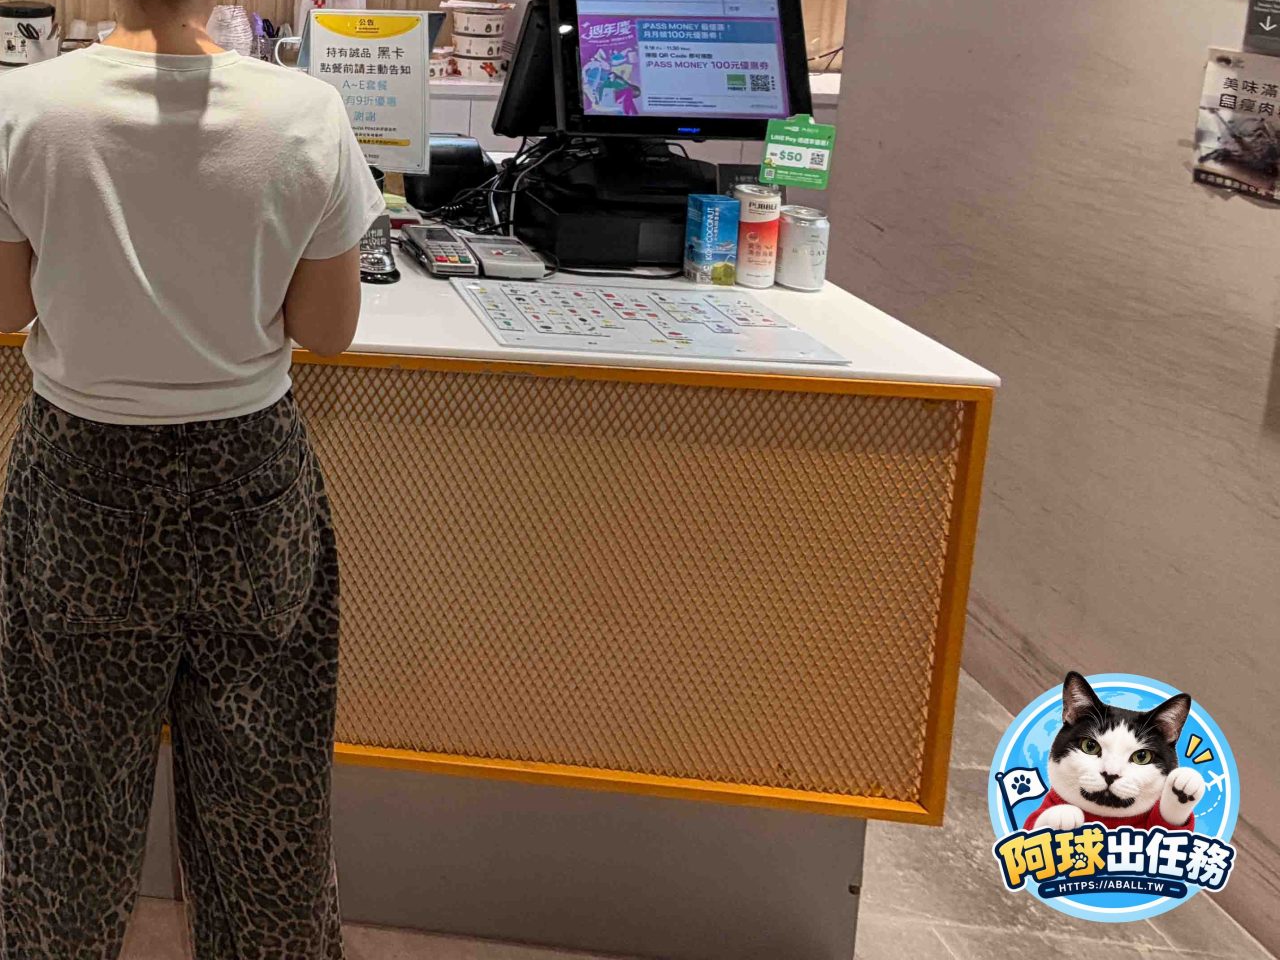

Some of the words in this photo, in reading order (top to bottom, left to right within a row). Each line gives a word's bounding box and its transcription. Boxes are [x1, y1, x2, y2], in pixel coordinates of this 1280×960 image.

[358, 18, 374, 26] 公告
[326, 46, 371, 59] 持有誠品
[377, 46, 405, 59] 黑卡
[320, 63, 412, 75] 點餐前請主動告知
[344, 95, 398, 107] 有9折優惠
[354, 111, 377, 123] 謝謝
[779, 150, 803, 162] $50
